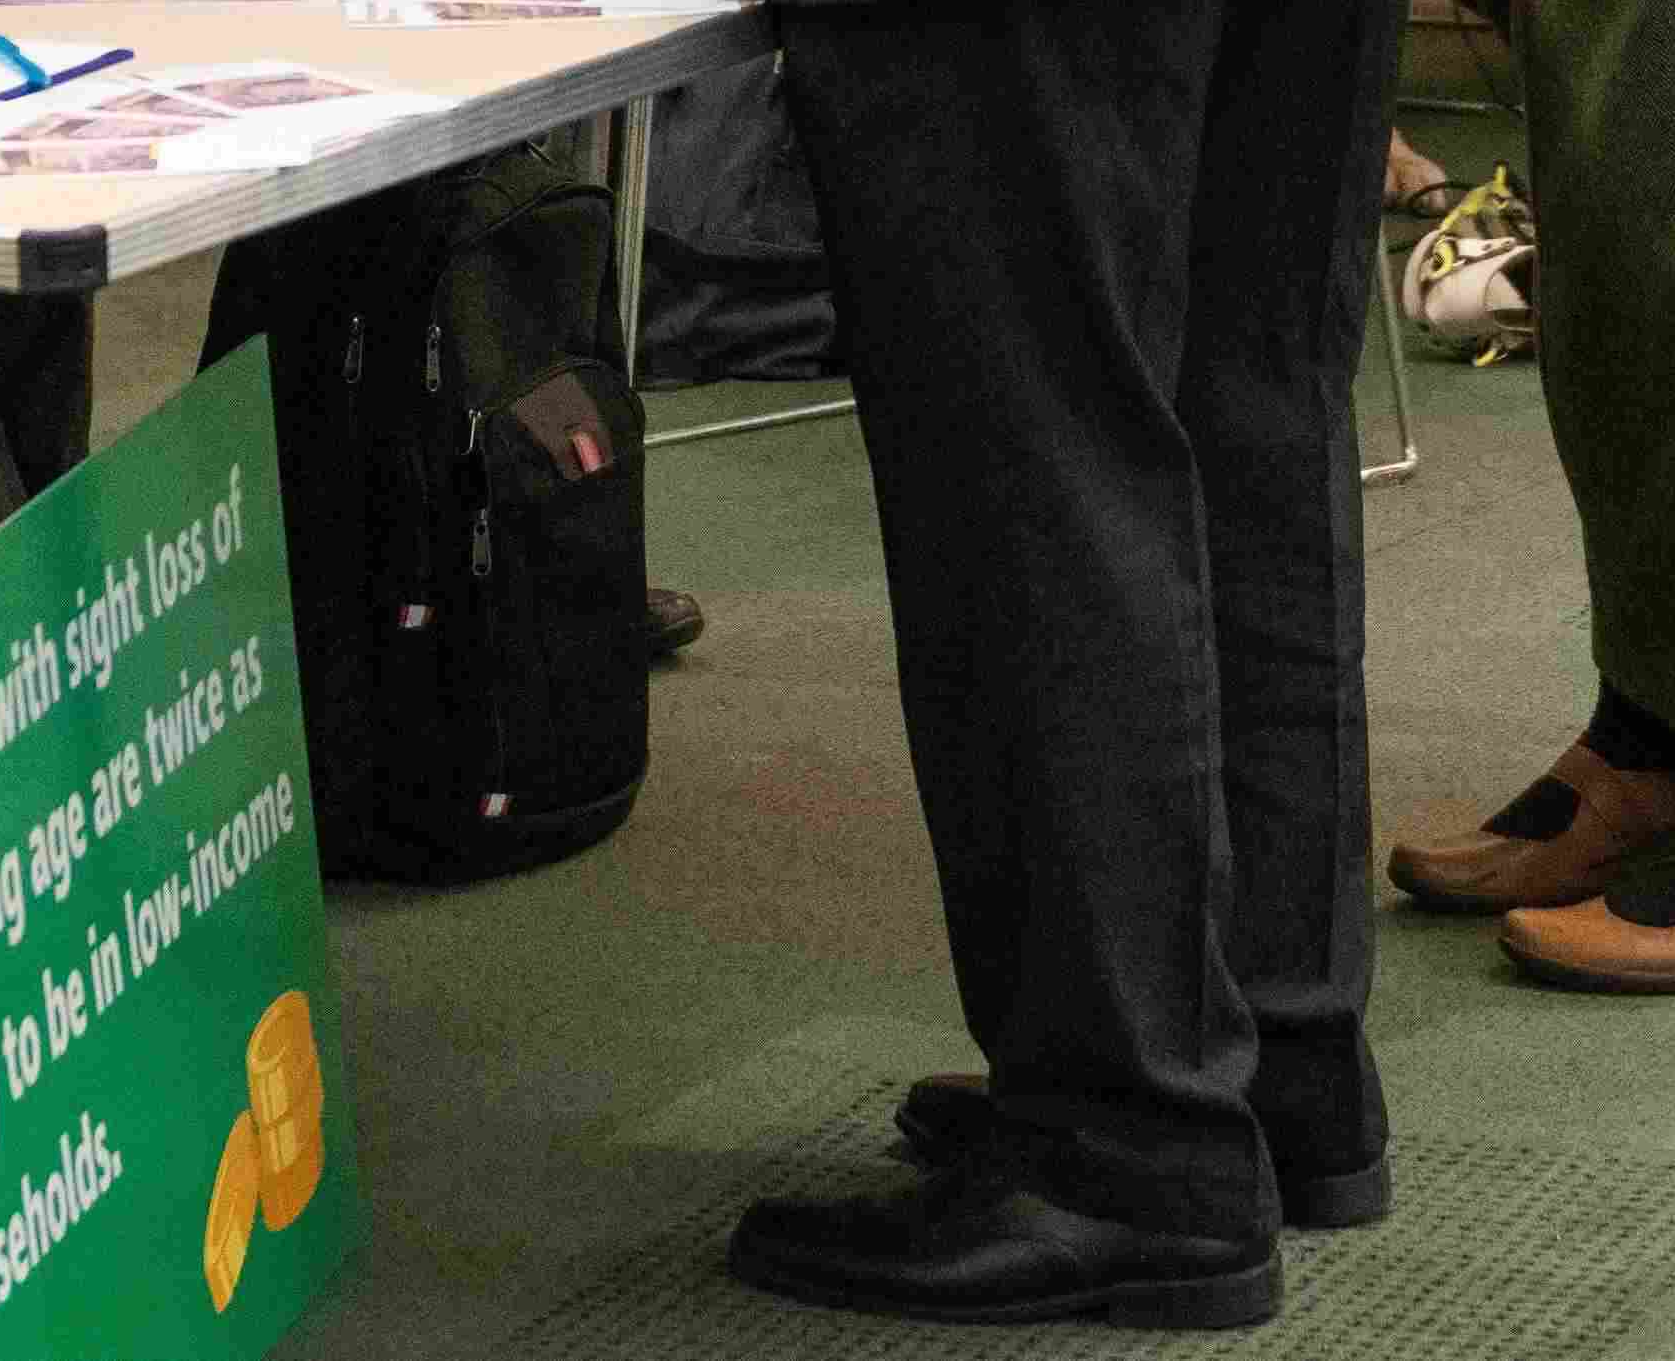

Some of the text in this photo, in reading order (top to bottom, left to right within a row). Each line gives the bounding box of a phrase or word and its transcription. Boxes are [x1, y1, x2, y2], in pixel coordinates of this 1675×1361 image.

[64, 558, 145, 689] sight
[146, 519, 206, 618] loss
[213, 462, 243, 565] of
[29, 791, 87, 902] age
[92, 742, 143, 838] are
[146, 670, 226, 785] twice
[231, 635, 263, 712] as
[2, 1016, 41, 1101] to
[42, 967, 88, 1061] be
[87, 923, 124, 1014] in
[124, 772, 294, 978] low-income
